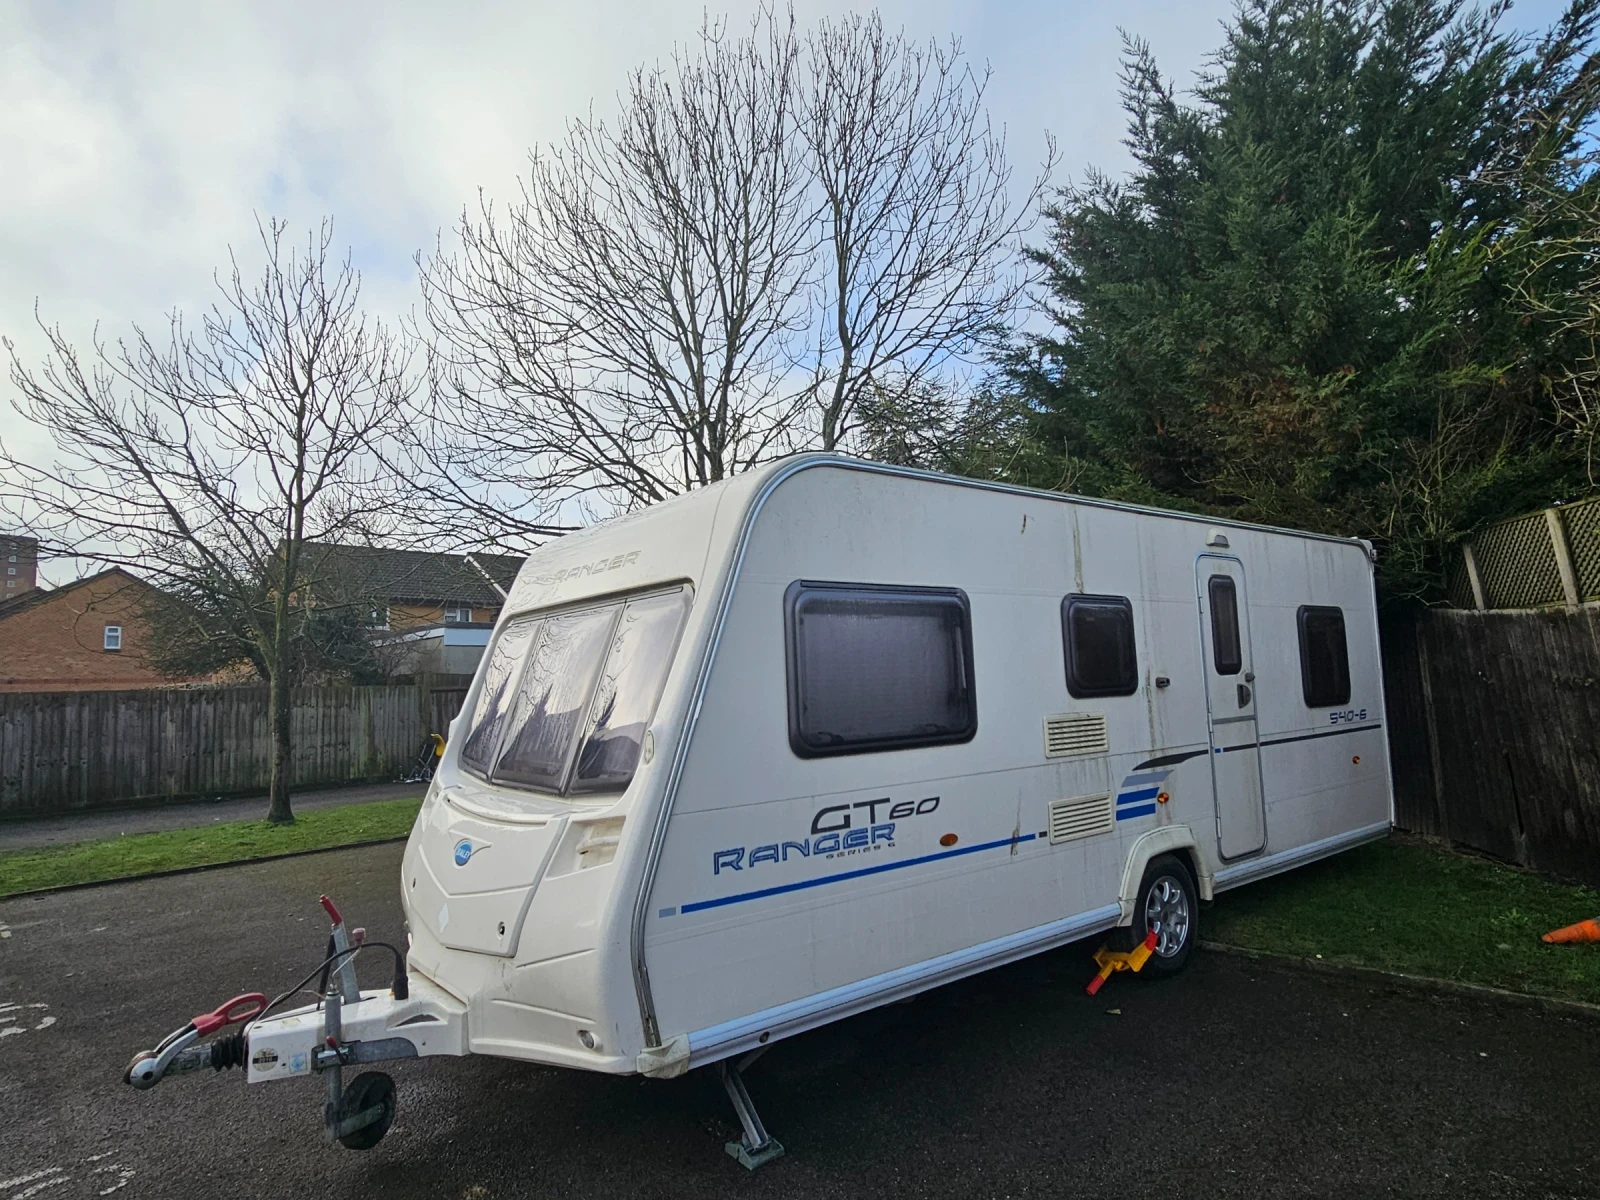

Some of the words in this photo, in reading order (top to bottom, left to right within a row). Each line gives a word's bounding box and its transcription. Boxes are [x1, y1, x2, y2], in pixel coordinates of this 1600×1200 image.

[554, 550, 642, 583] RANGER
[1329, 708, 1367, 725] 540-6
[713, 823, 896, 875] RANGER
[826, 845, 881, 860] SERIES
